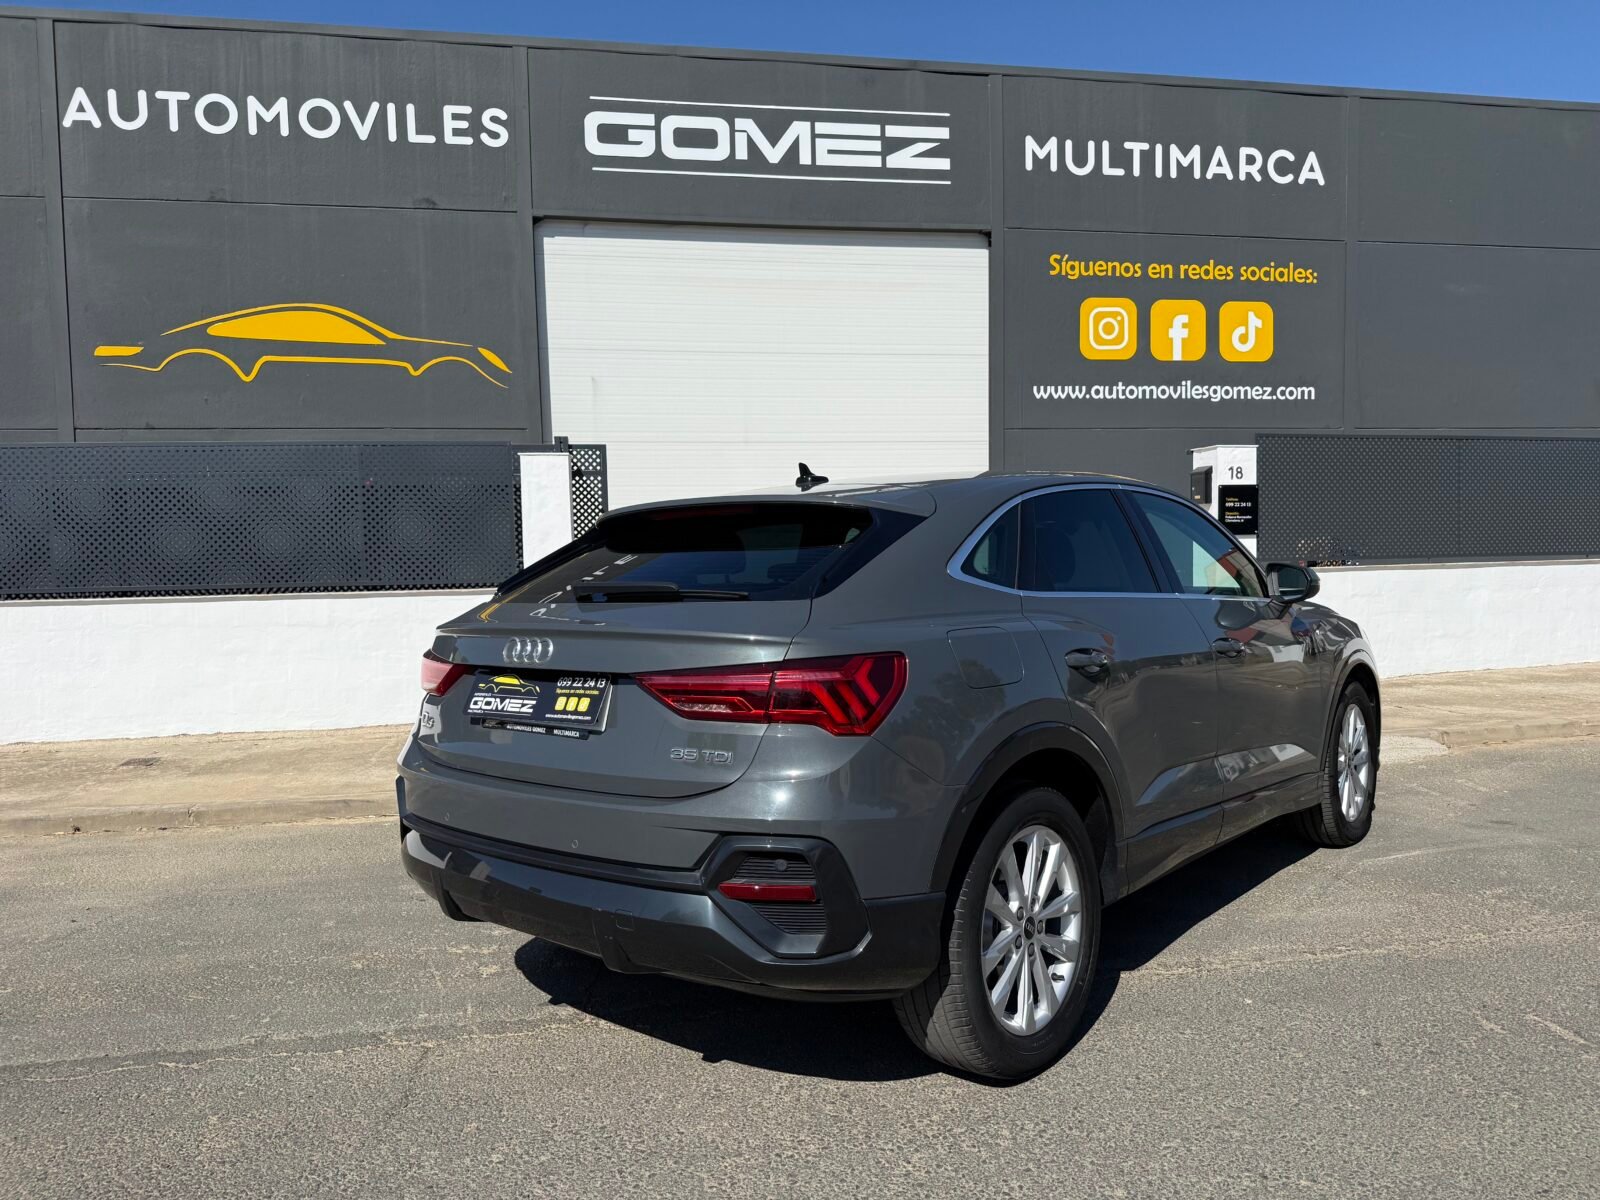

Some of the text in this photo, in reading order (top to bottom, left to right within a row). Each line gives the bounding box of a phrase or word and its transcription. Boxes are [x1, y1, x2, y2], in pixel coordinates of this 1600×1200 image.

[62, 87, 508, 148] AUTOMOVILES
[584, 111, 951, 171] GOMEZ
[1025, 135, 1326, 186] MULTIMARCA
[1049, 254, 1317, 284] Síguenos en redes sociales:
[1033, 380, 1316, 403] www.automovilesgomez.com
[1228, 466, 1243, 480] 18
[557, 677, 606, 688] 699 22 24 13
[470, 697, 537, 713] GOMEZ
[553, 729, 580, 738] MULTIMARCA
[671, 748, 733, 764] 35 TDI
